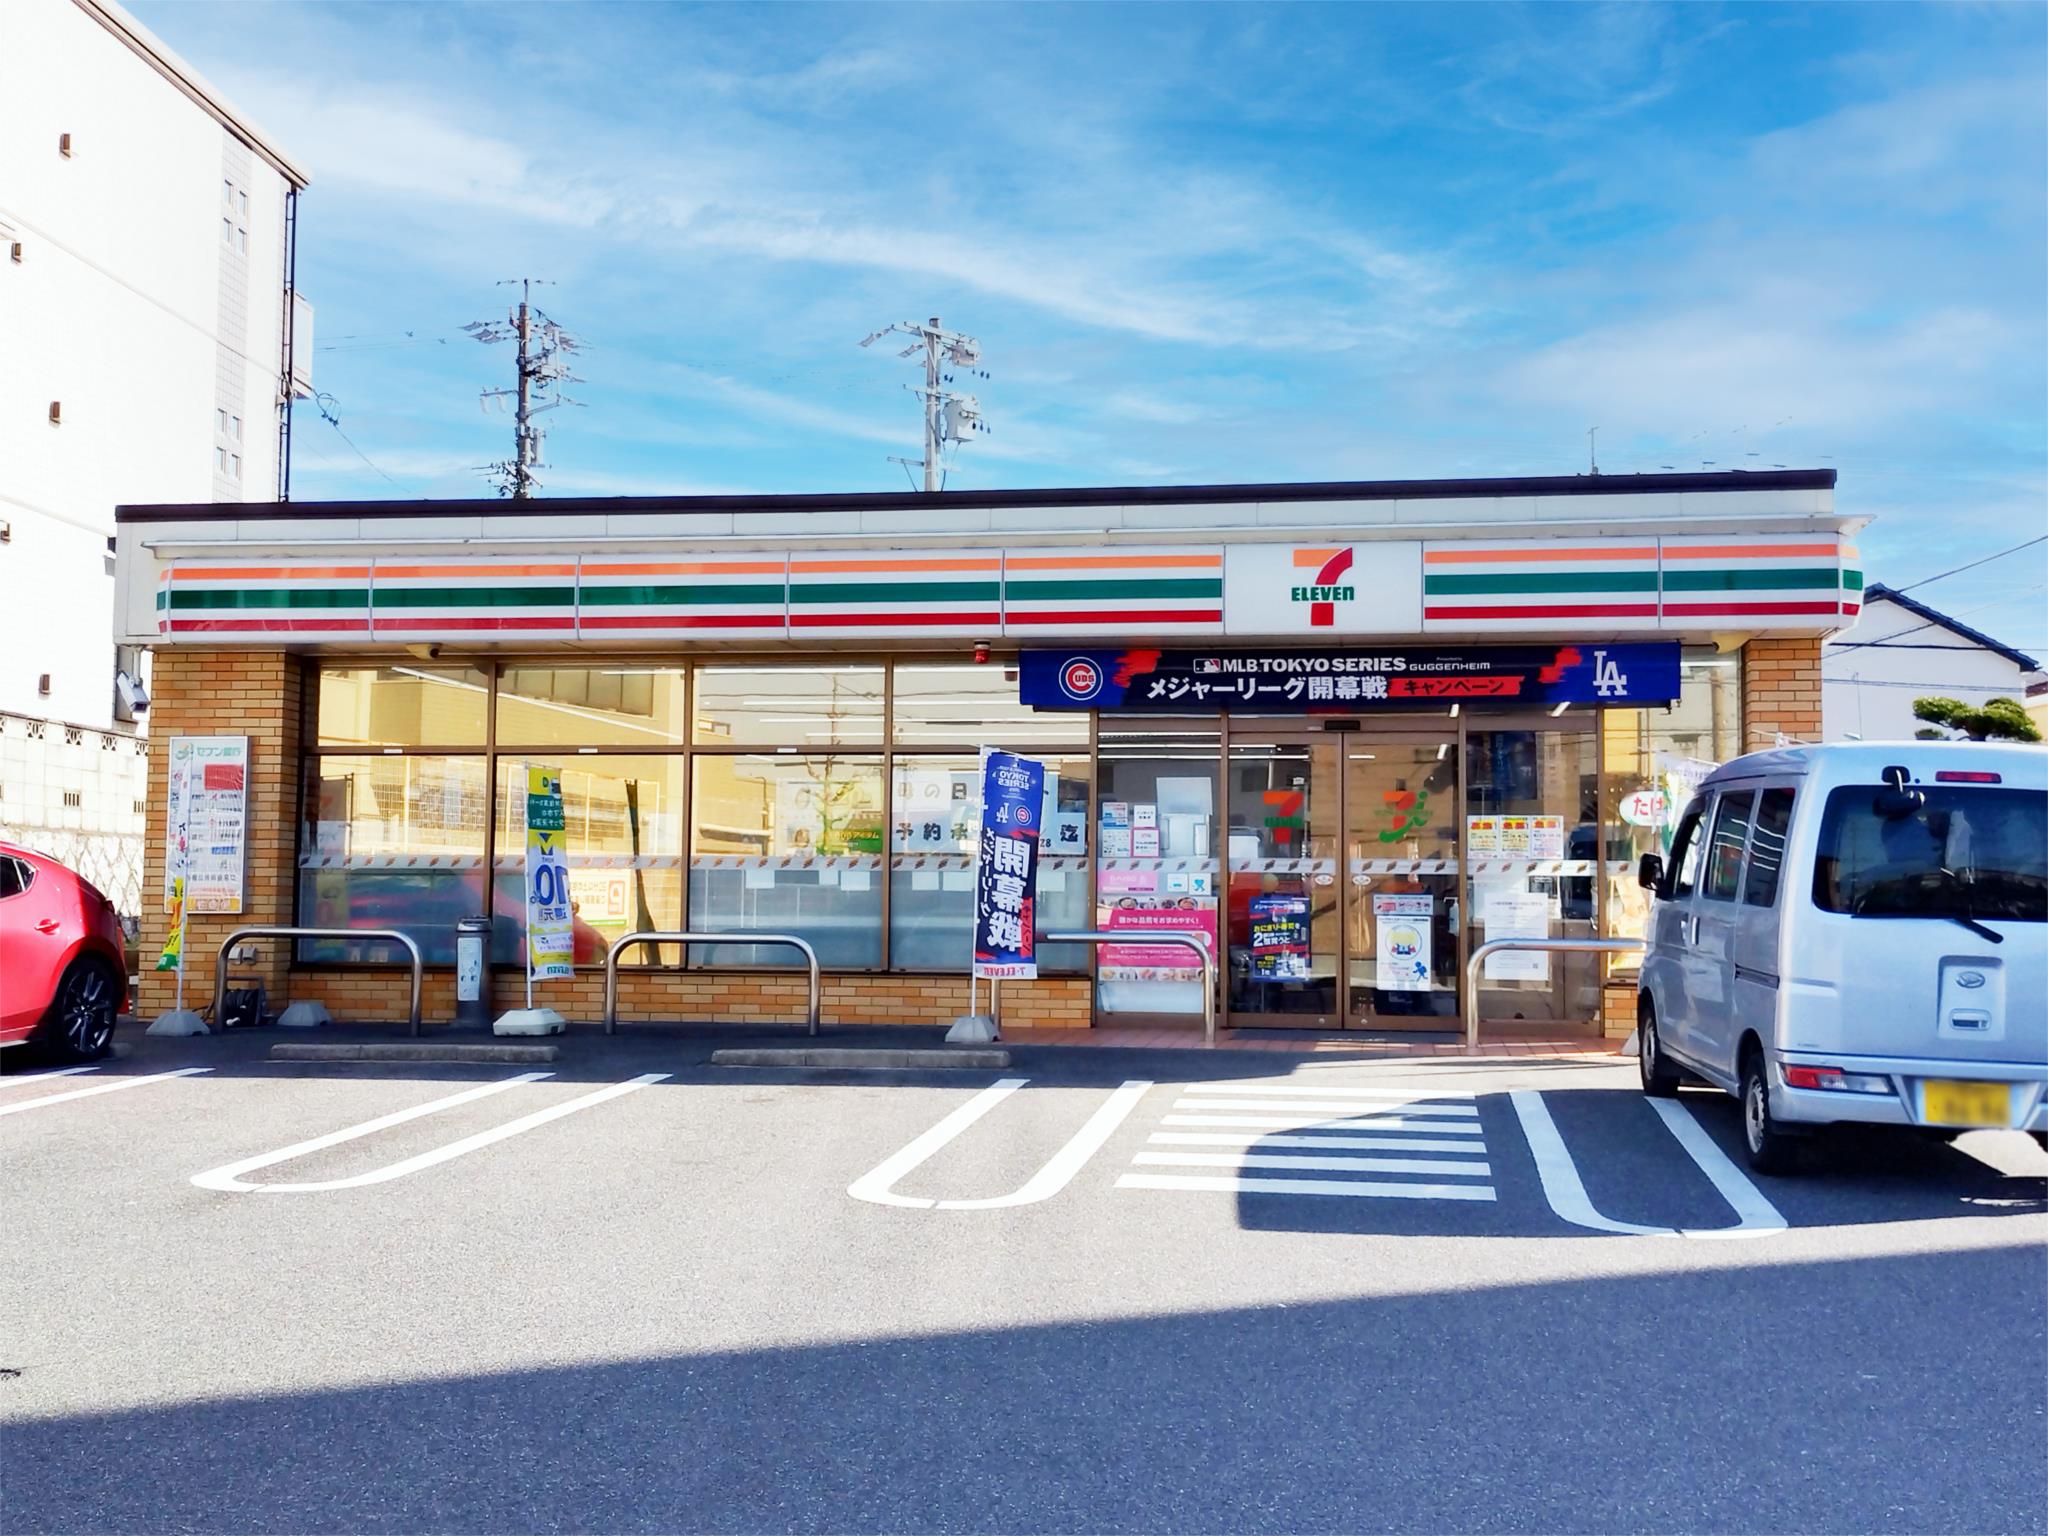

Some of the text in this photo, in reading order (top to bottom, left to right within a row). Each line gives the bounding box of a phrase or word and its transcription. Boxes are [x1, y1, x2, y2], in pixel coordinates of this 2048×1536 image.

[1293, 547, 1353, 626] 7
[1223, 657, 1491, 673] MLB TOKYO SERIES GUGGENHEIM
[1593, 651, 1627, 696] LA
[1147, 676, 1504, 700] メジャーリーグ開幕戦 キャンペーン
